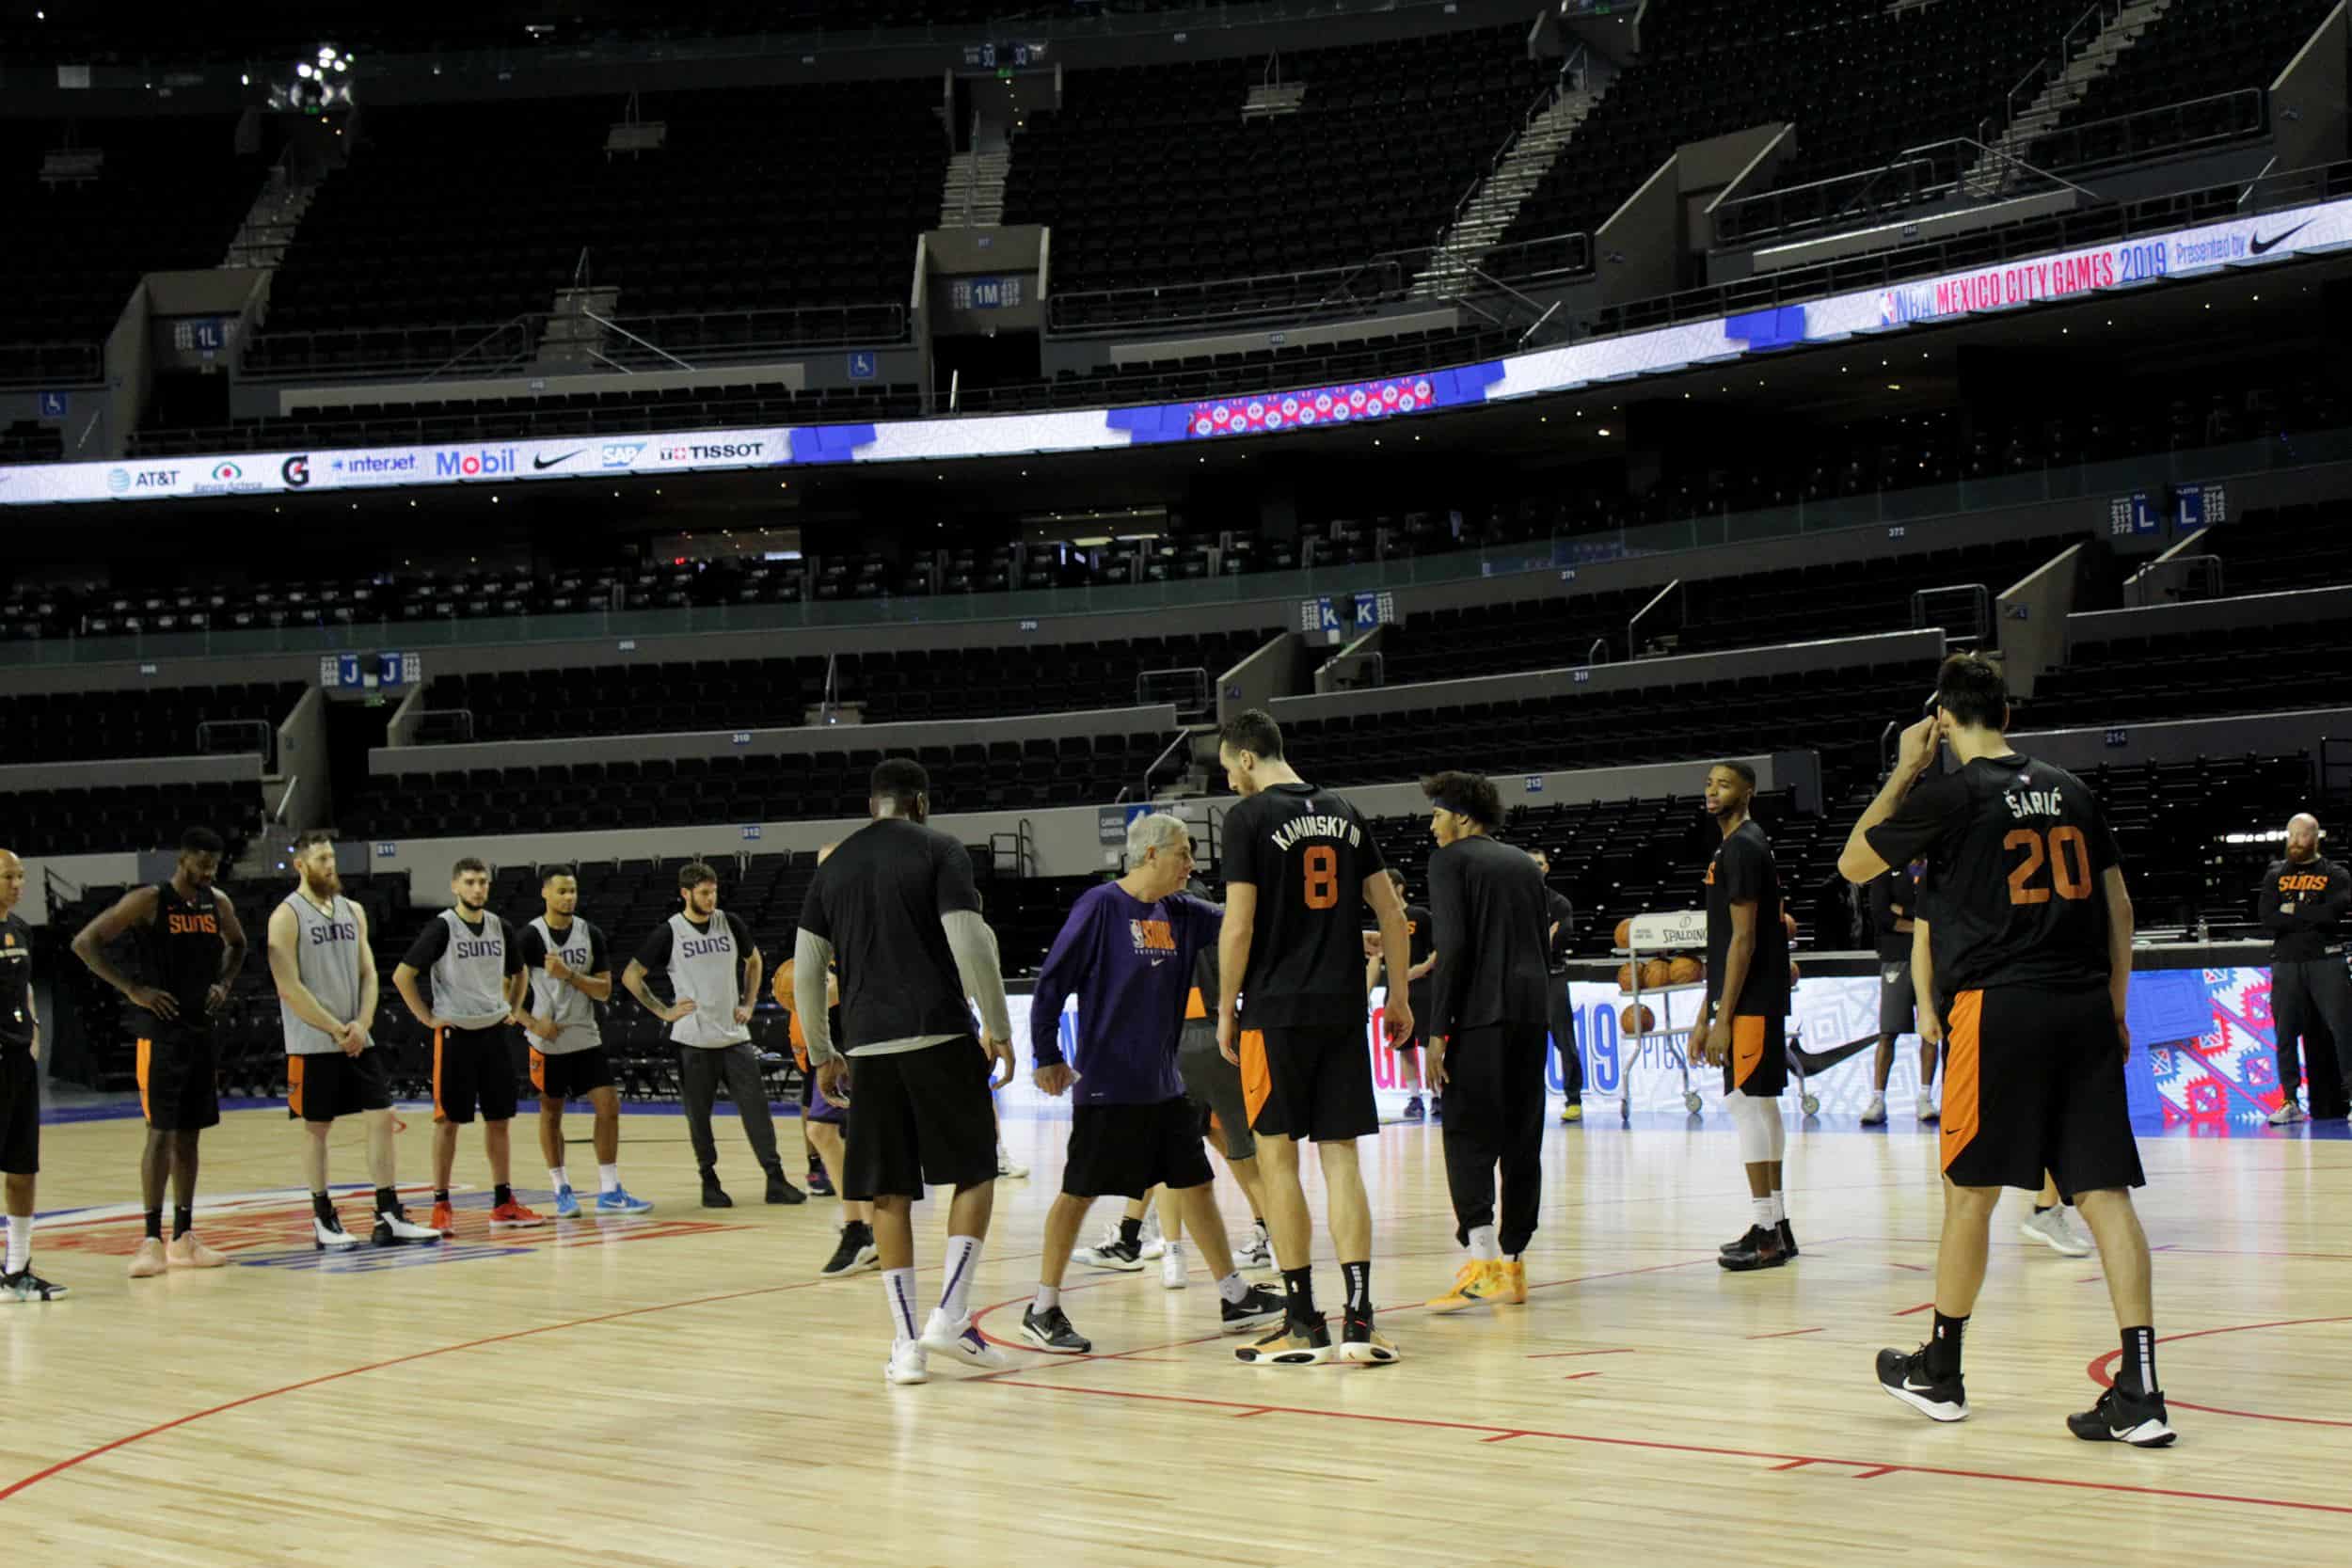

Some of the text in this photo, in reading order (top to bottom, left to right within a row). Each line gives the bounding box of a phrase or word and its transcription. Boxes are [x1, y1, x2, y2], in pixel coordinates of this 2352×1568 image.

[1896, 233, 2245, 324] NBA MEXICO CITY GAMES 2019 Presented by
[975, 285, 998, 304] 1M
[198, 326, 218, 346] 1L
[437, 448, 515, 475] Mobil
[603, 444, 639, 464] SAP
[690, 443, 764, 460] TISSOT
[135, 470, 180, 486] AT&T
[282, 455, 310, 486] G
[2138, 505, 2154, 527] L
[2180, 499, 2198, 525] L
[1889, 527, 1905, 537] 372
[1322, 607, 1339, 626] K
[1357, 603, 1374, 624] K
[344, 662, 358, 684] J
[383, 661, 395, 682] J
[2004, 788, 2062, 819] ŠARIĆ
[1271, 816, 1361, 851] KAMINSKY III
[2002, 824, 2093, 905] 20
[1302, 845, 1339, 910] 8
[2279, 874, 2329, 893] SUNS
[168, 913, 218, 933] SUNS
[310, 923, 356, 945] SUNS
[457, 940, 502, 958] SUNS
[682, 936, 731, 958] SUNS
